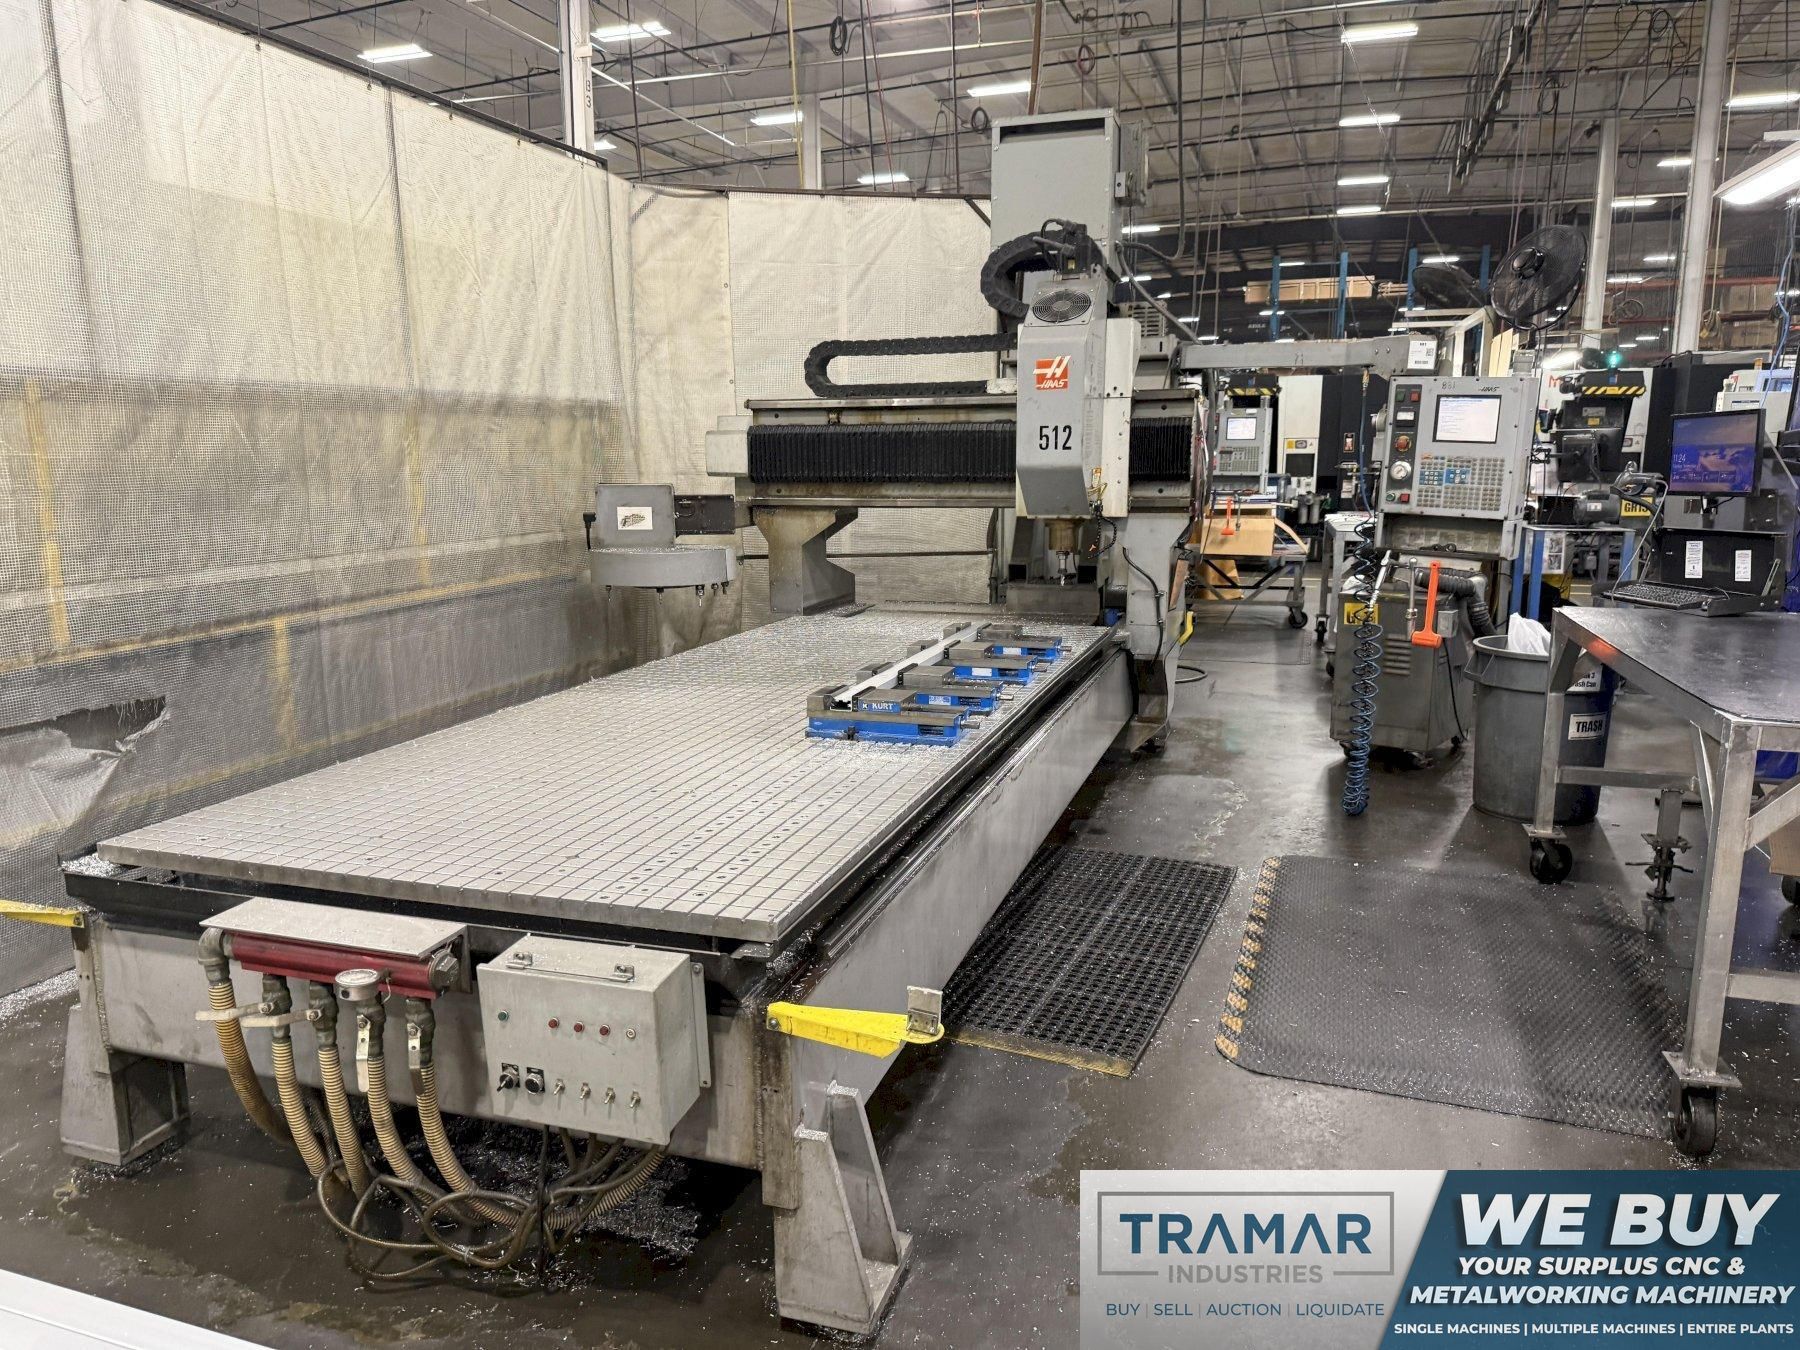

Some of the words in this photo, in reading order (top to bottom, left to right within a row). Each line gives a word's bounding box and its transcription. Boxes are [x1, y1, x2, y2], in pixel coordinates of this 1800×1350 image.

[1036, 379, 1067, 389] HAAS
[1039, 425, 1072, 450] 512
[872, 702, 894, 710] KURT
[1575, 720, 1603, 733] TRASH
